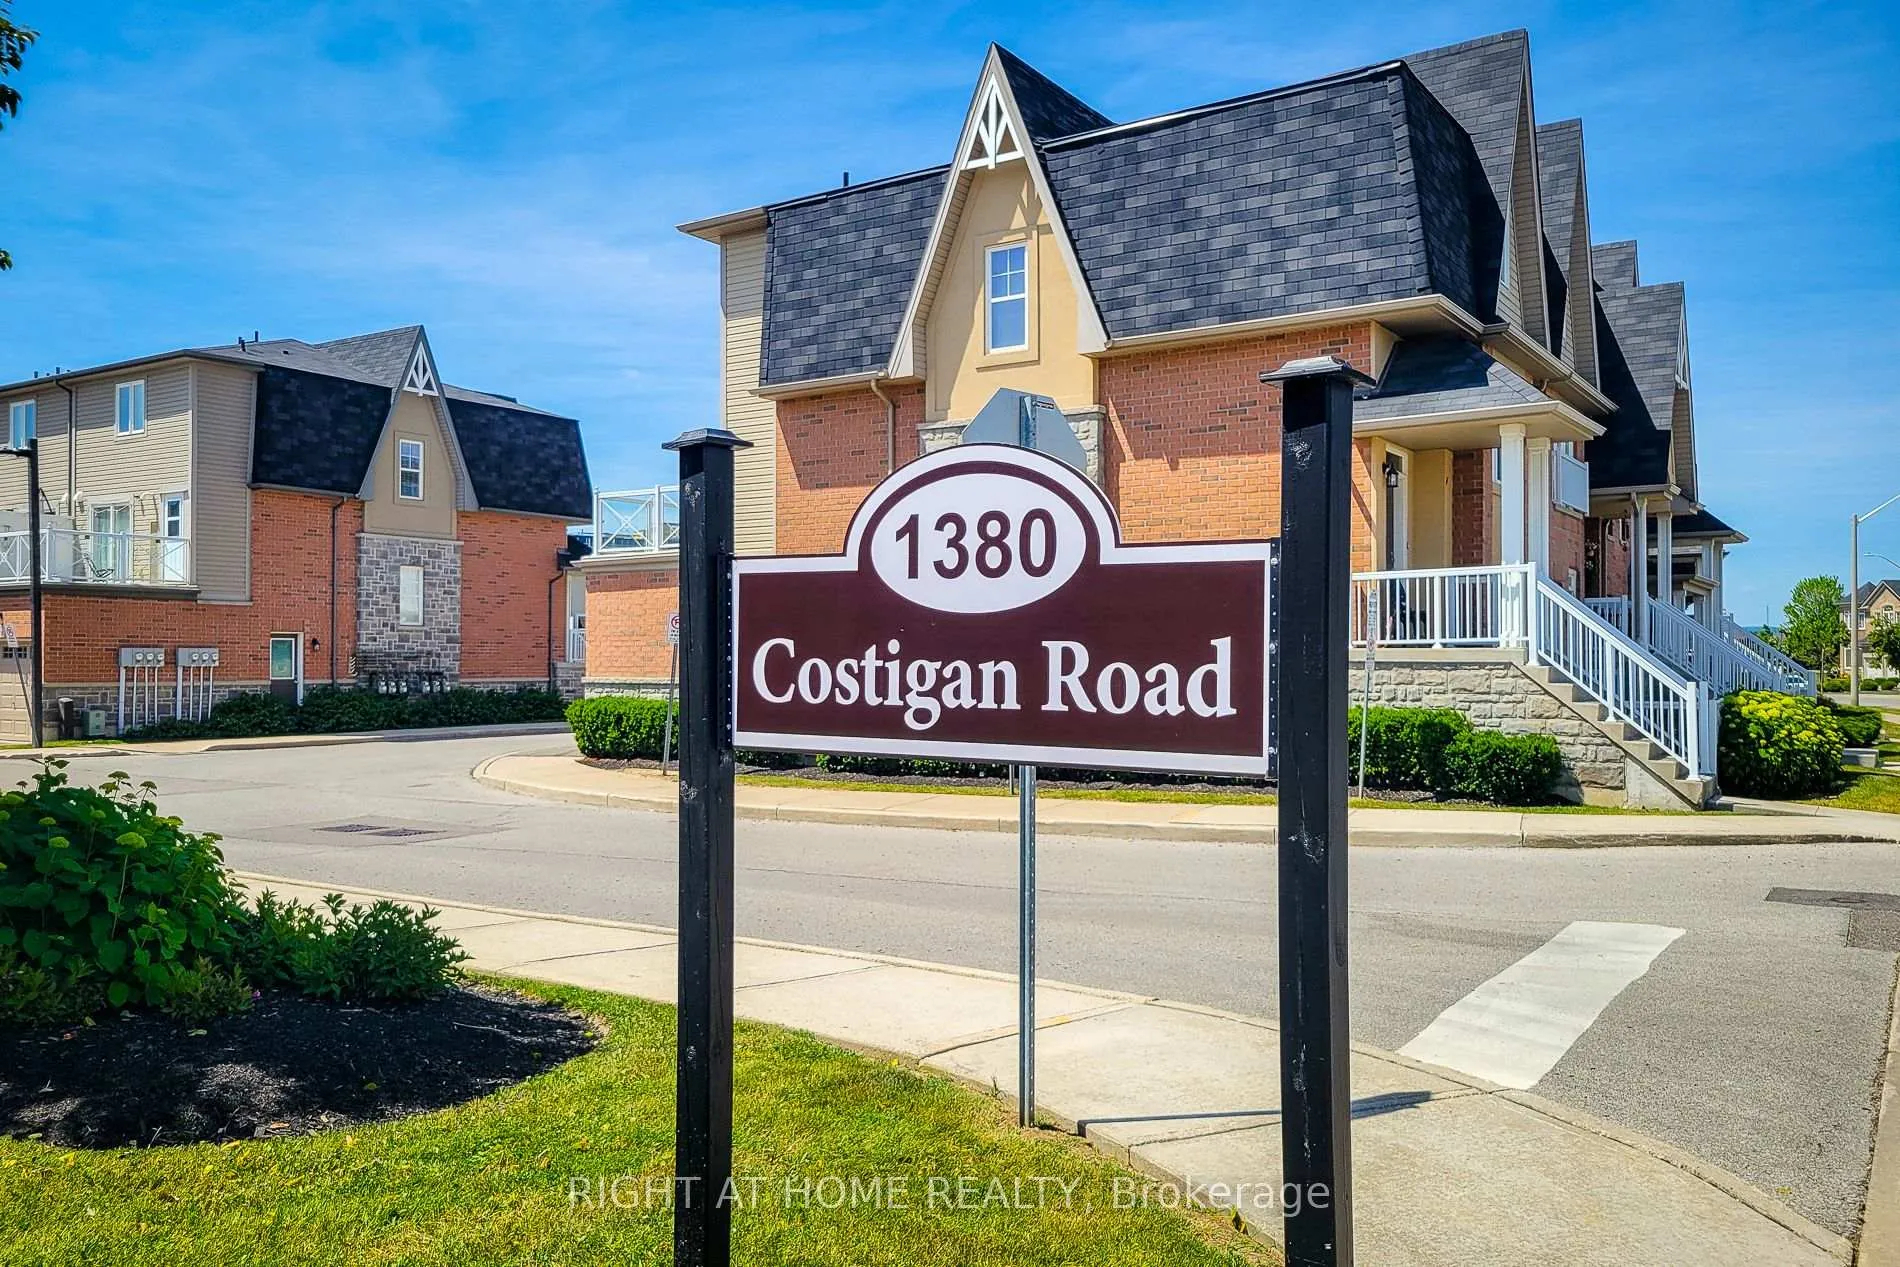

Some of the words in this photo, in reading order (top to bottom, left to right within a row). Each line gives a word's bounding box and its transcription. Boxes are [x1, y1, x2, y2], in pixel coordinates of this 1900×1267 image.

[895, 508, 1057, 580] 1380
[752, 637, 1021, 731] Costigan
[1041, 636, 1238, 718] Road
